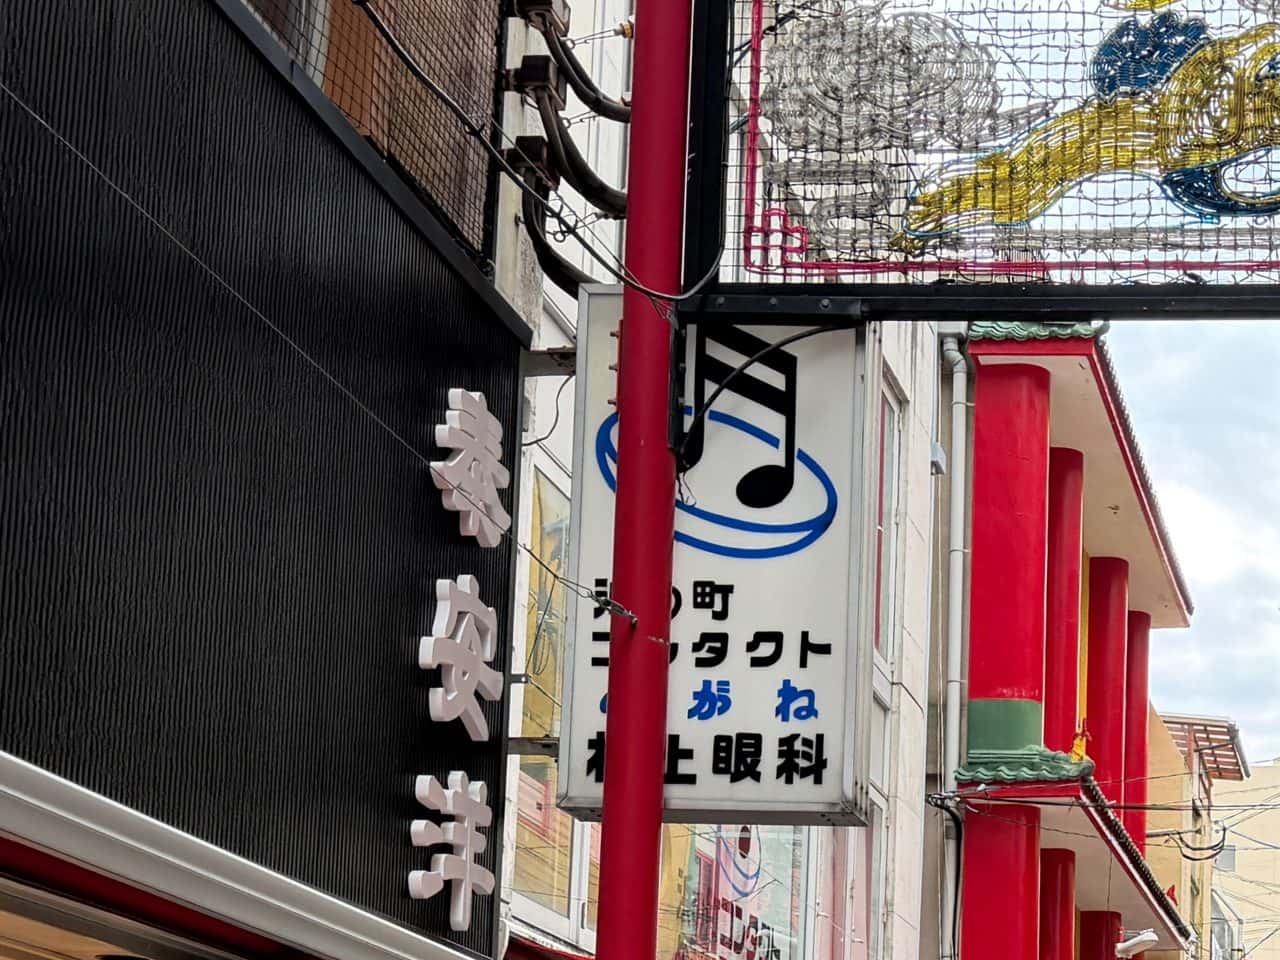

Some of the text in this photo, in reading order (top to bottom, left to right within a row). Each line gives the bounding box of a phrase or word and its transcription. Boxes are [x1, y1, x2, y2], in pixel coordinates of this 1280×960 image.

[591, 630, 832, 669] タクト
[599, 678, 818, 723] がね
